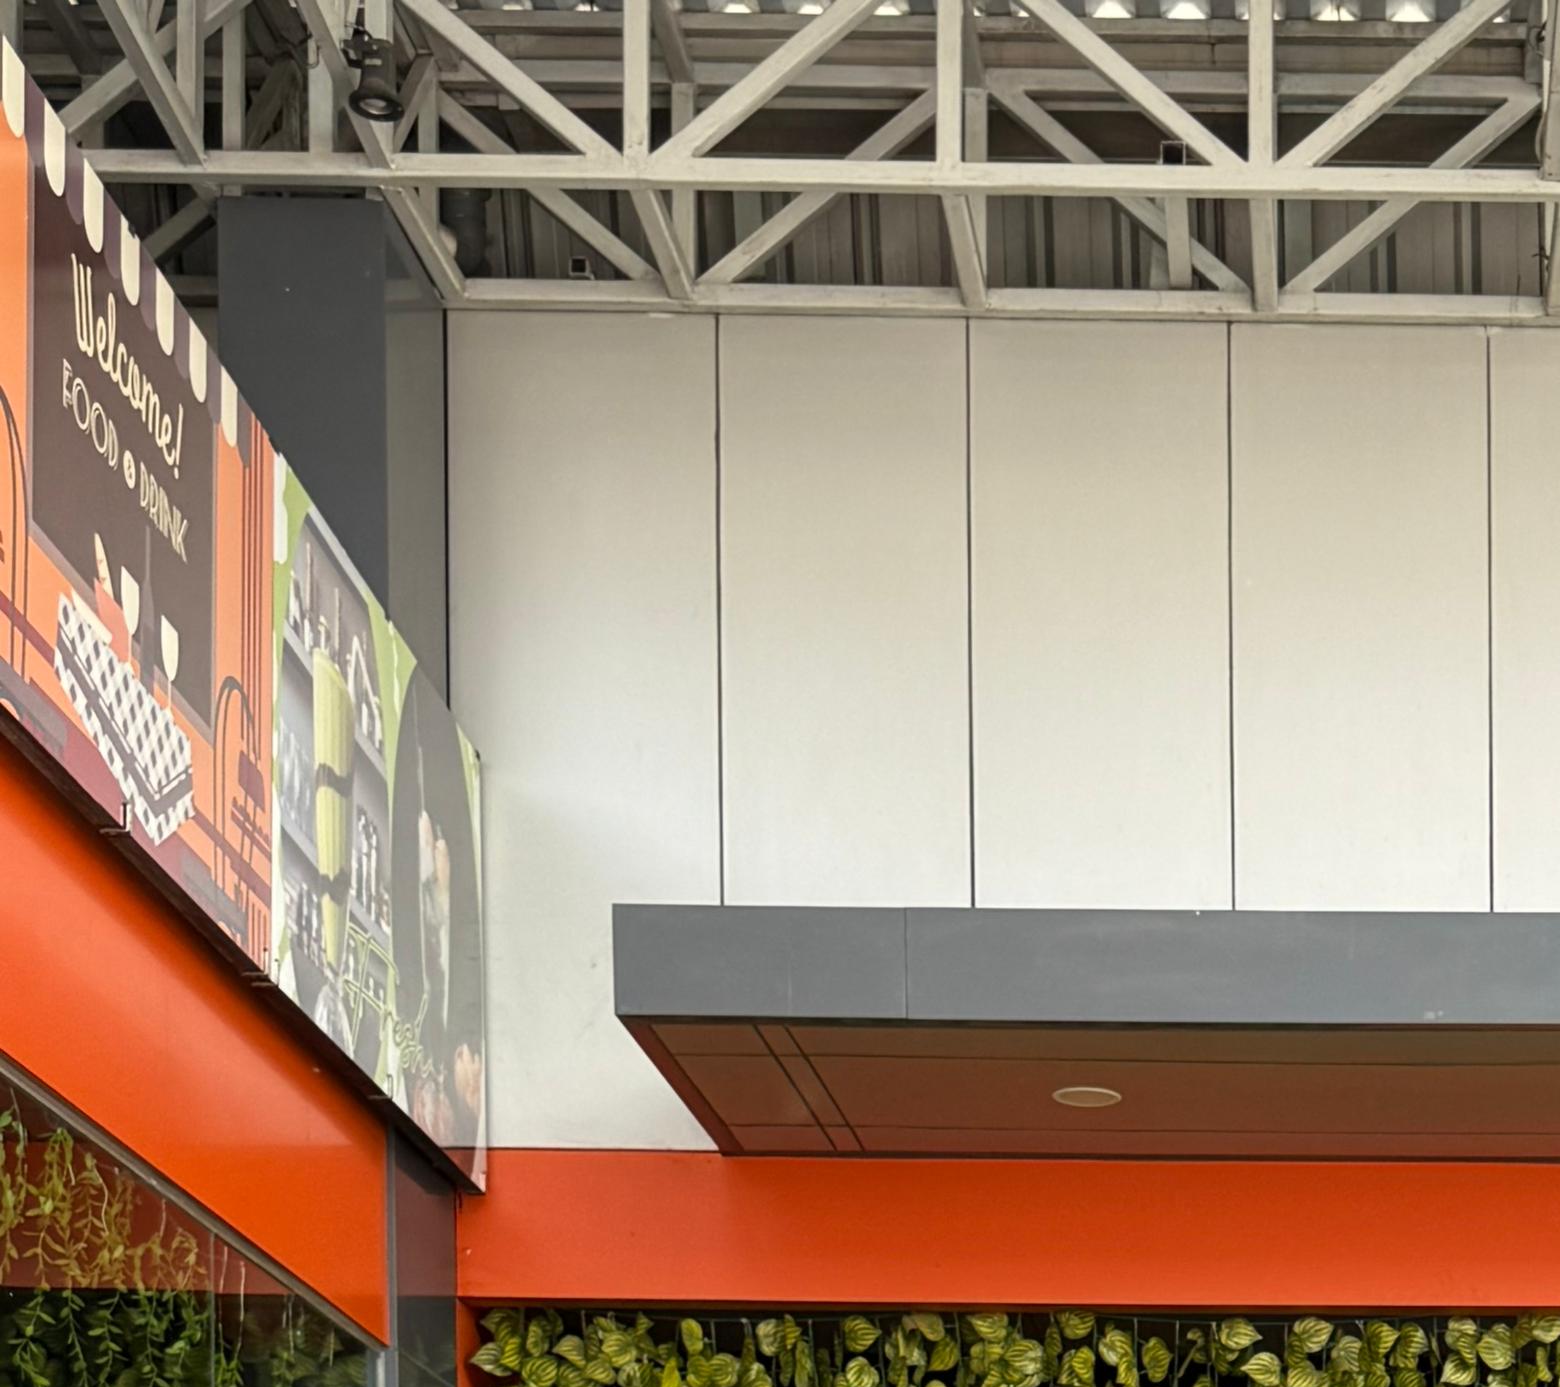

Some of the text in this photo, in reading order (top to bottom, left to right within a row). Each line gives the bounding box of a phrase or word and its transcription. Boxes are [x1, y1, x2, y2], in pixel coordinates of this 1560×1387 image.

[63, 358, 119, 471] FOOD
[140, 461, 188, 564] DRINK
[71, 252, 184, 480] Welcome!
